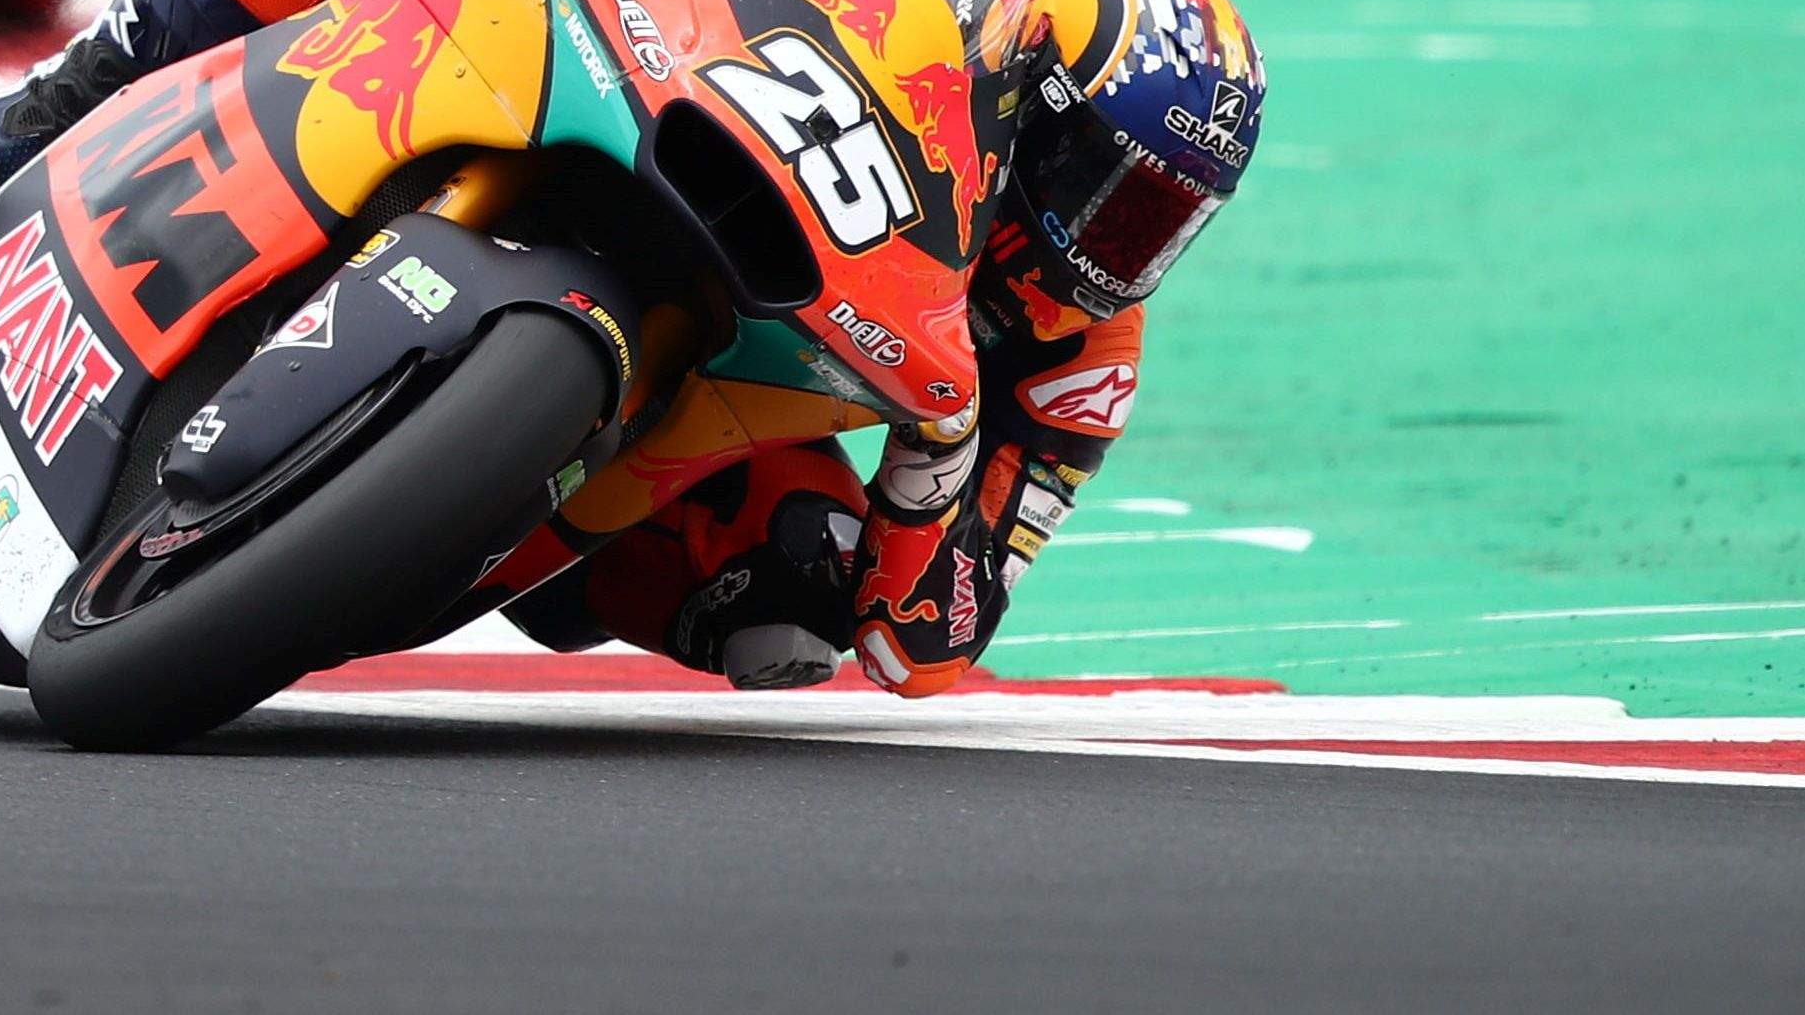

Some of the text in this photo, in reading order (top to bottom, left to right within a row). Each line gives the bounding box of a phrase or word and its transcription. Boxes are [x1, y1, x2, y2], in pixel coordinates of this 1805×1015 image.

[565, 12, 615, 100] MOTOREX
[1052, 63, 1086, 104] SHARK
[705, 32, 920, 248] 25
[1113, 130, 1167, 174] GIVES
[1174, 170, 1208, 197] YOU
[1164, 105, 1249, 168] SHARK
[76, 76, 261, 333] KTM
[387, 256, 458, 313] NG
[807, 360, 864, 402] MOTOREX
[949, 547, 978, 648] AVANT
